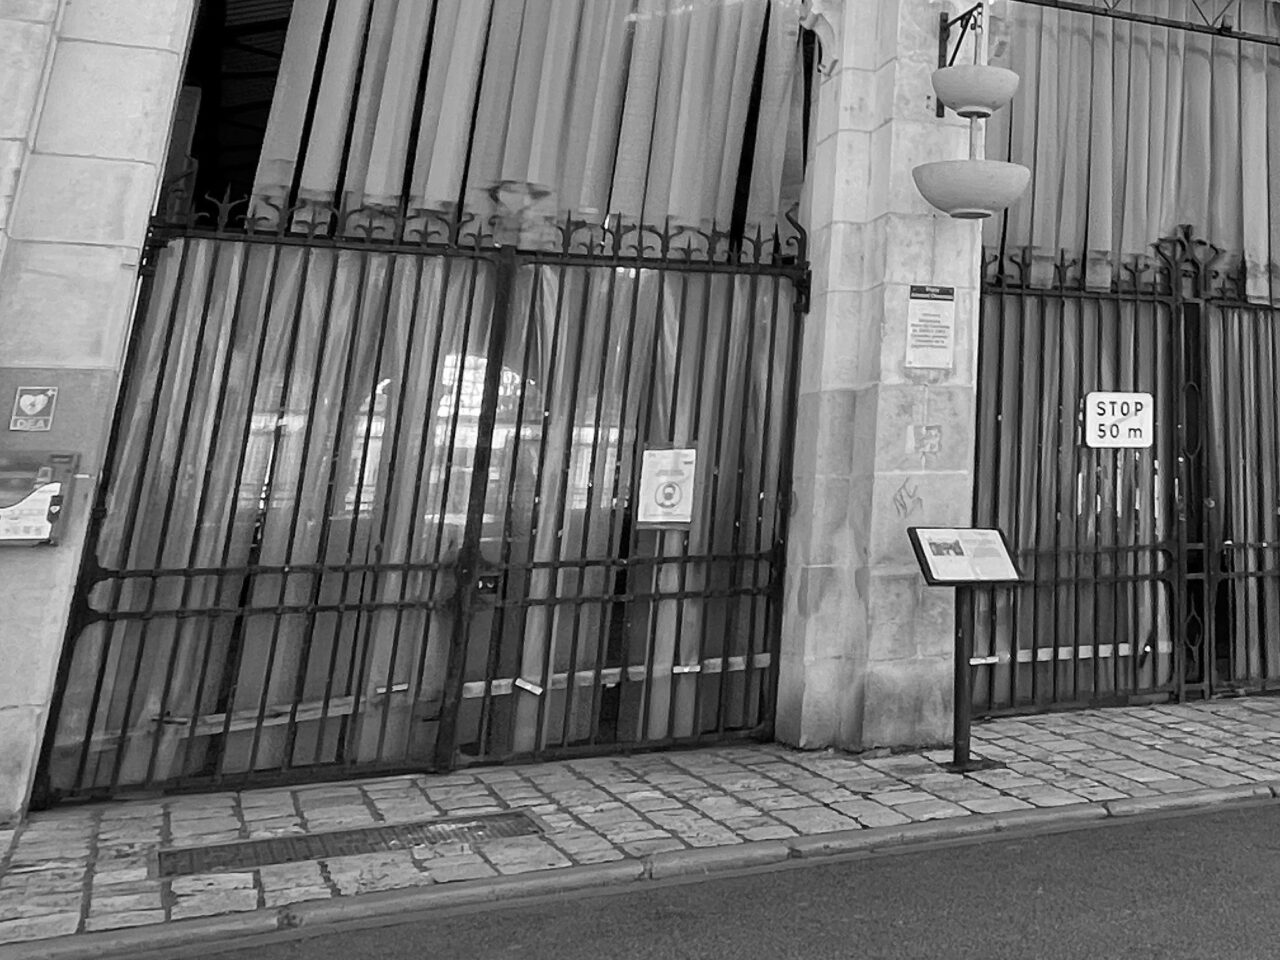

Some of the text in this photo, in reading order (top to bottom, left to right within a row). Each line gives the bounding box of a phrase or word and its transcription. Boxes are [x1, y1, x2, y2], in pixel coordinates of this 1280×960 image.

[1096, 401, 1144, 417] STOP
[16, 419, 46, 428] DEA
[1097, 423, 1143, 439] 50 m
